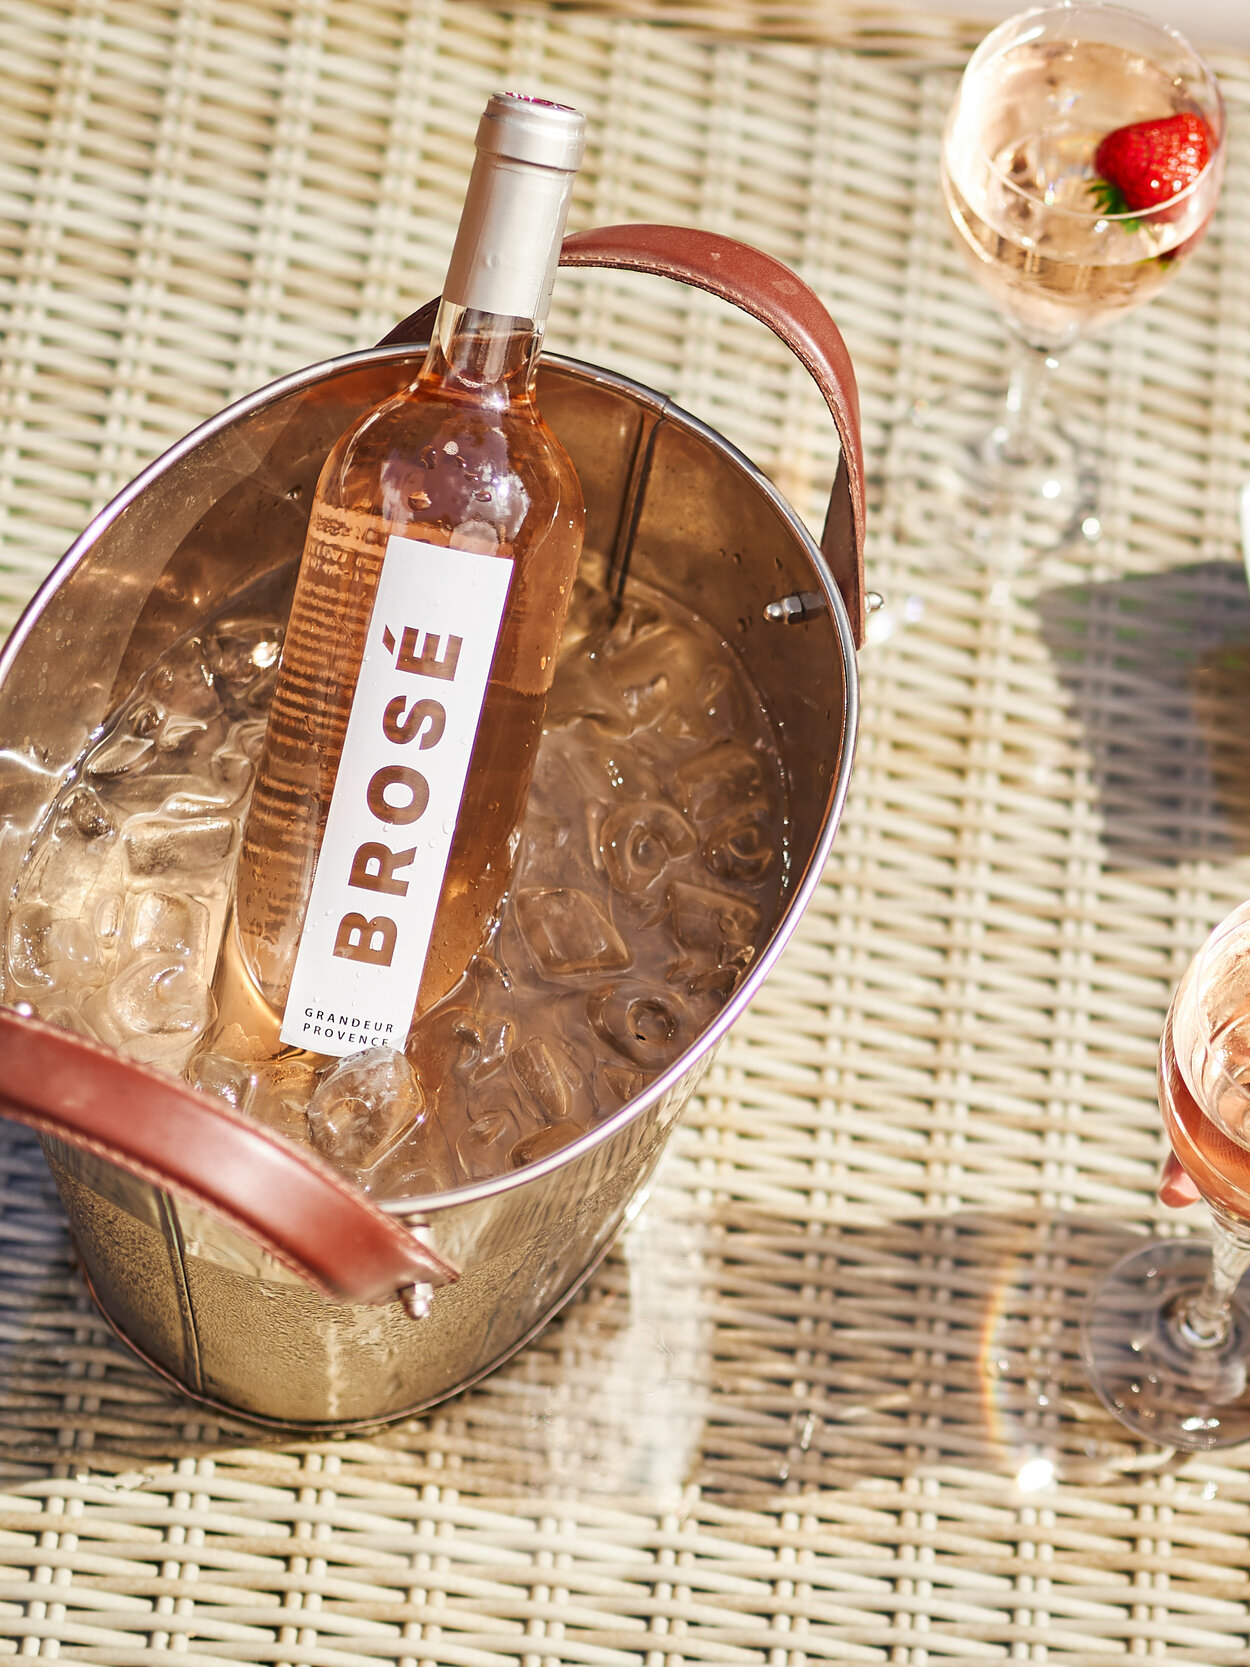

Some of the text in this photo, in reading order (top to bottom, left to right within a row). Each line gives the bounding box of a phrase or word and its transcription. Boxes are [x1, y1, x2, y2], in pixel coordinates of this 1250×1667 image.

[332, 624, 464, 968] BROSÉ
[304, 1007, 394, 1033] GRANDEUR
[303, 1022, 389, 1047] PROVENCE
